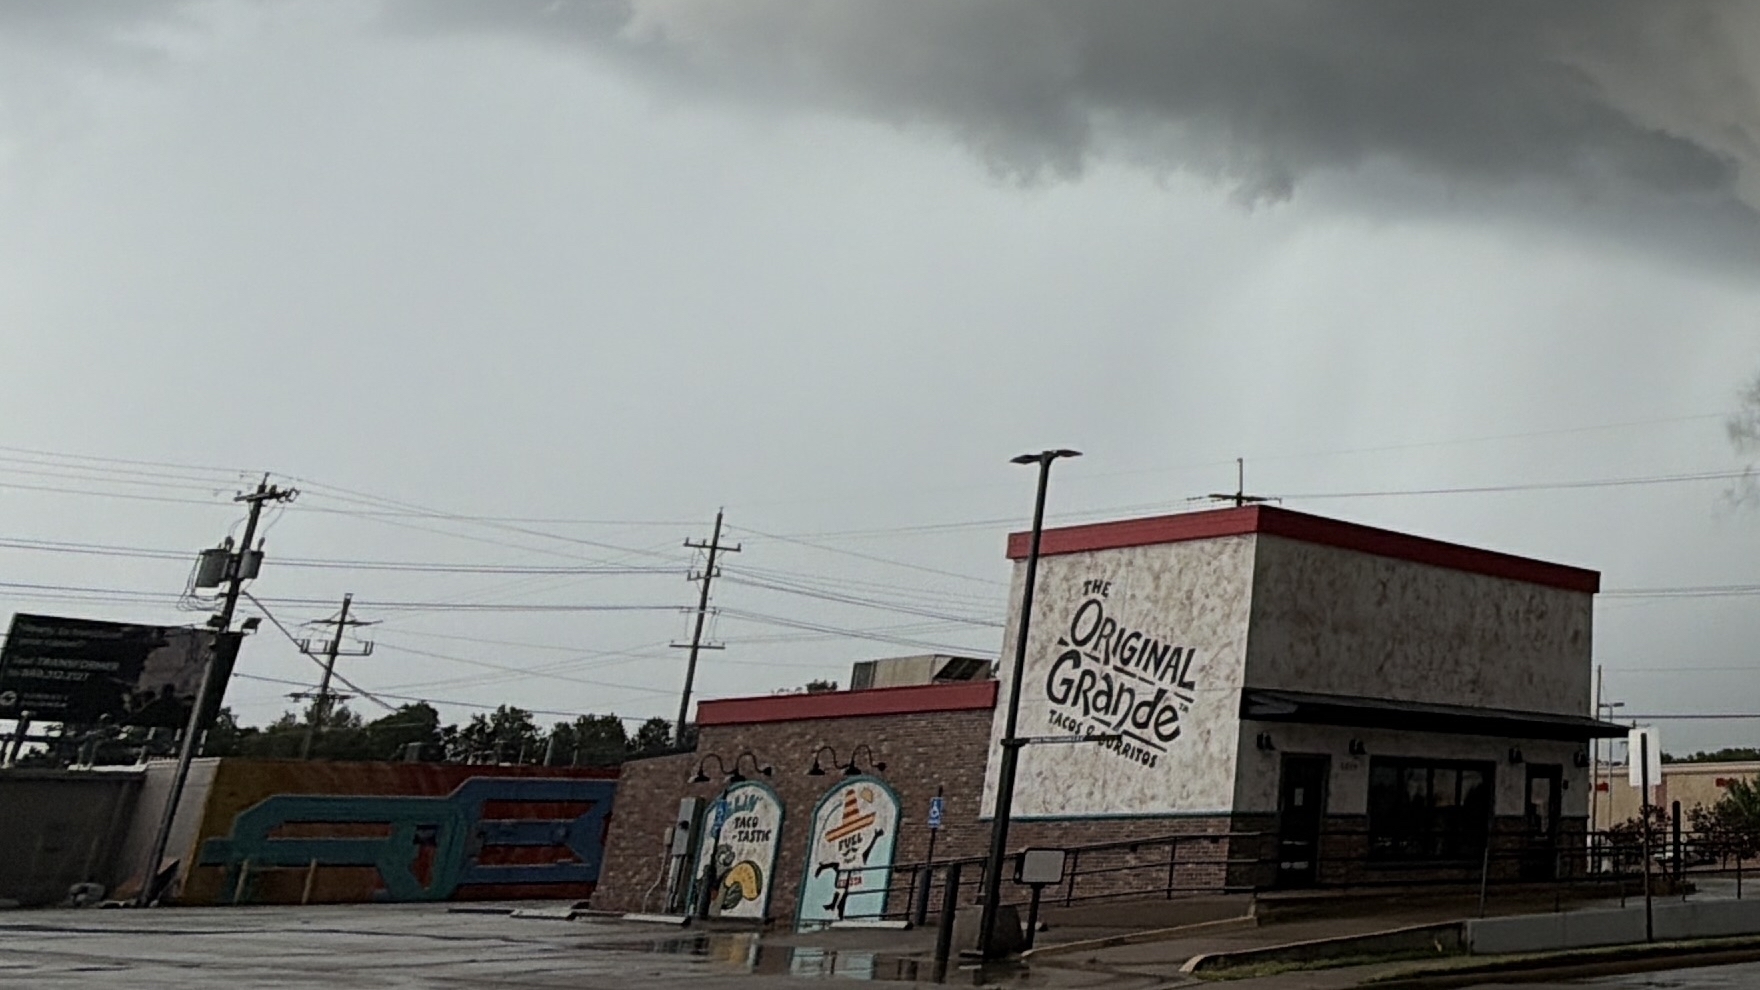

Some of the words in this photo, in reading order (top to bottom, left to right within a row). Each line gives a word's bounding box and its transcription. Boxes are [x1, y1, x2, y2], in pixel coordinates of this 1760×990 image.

[1082, 579, 1111, 598] THE
[1070, 598, 1196, 691] ORIGINAL
[1049, 708, 1083, 735] TACOS
[734, 816, 759, 830] TACO
[838, 833, 864, 852] FUEL
